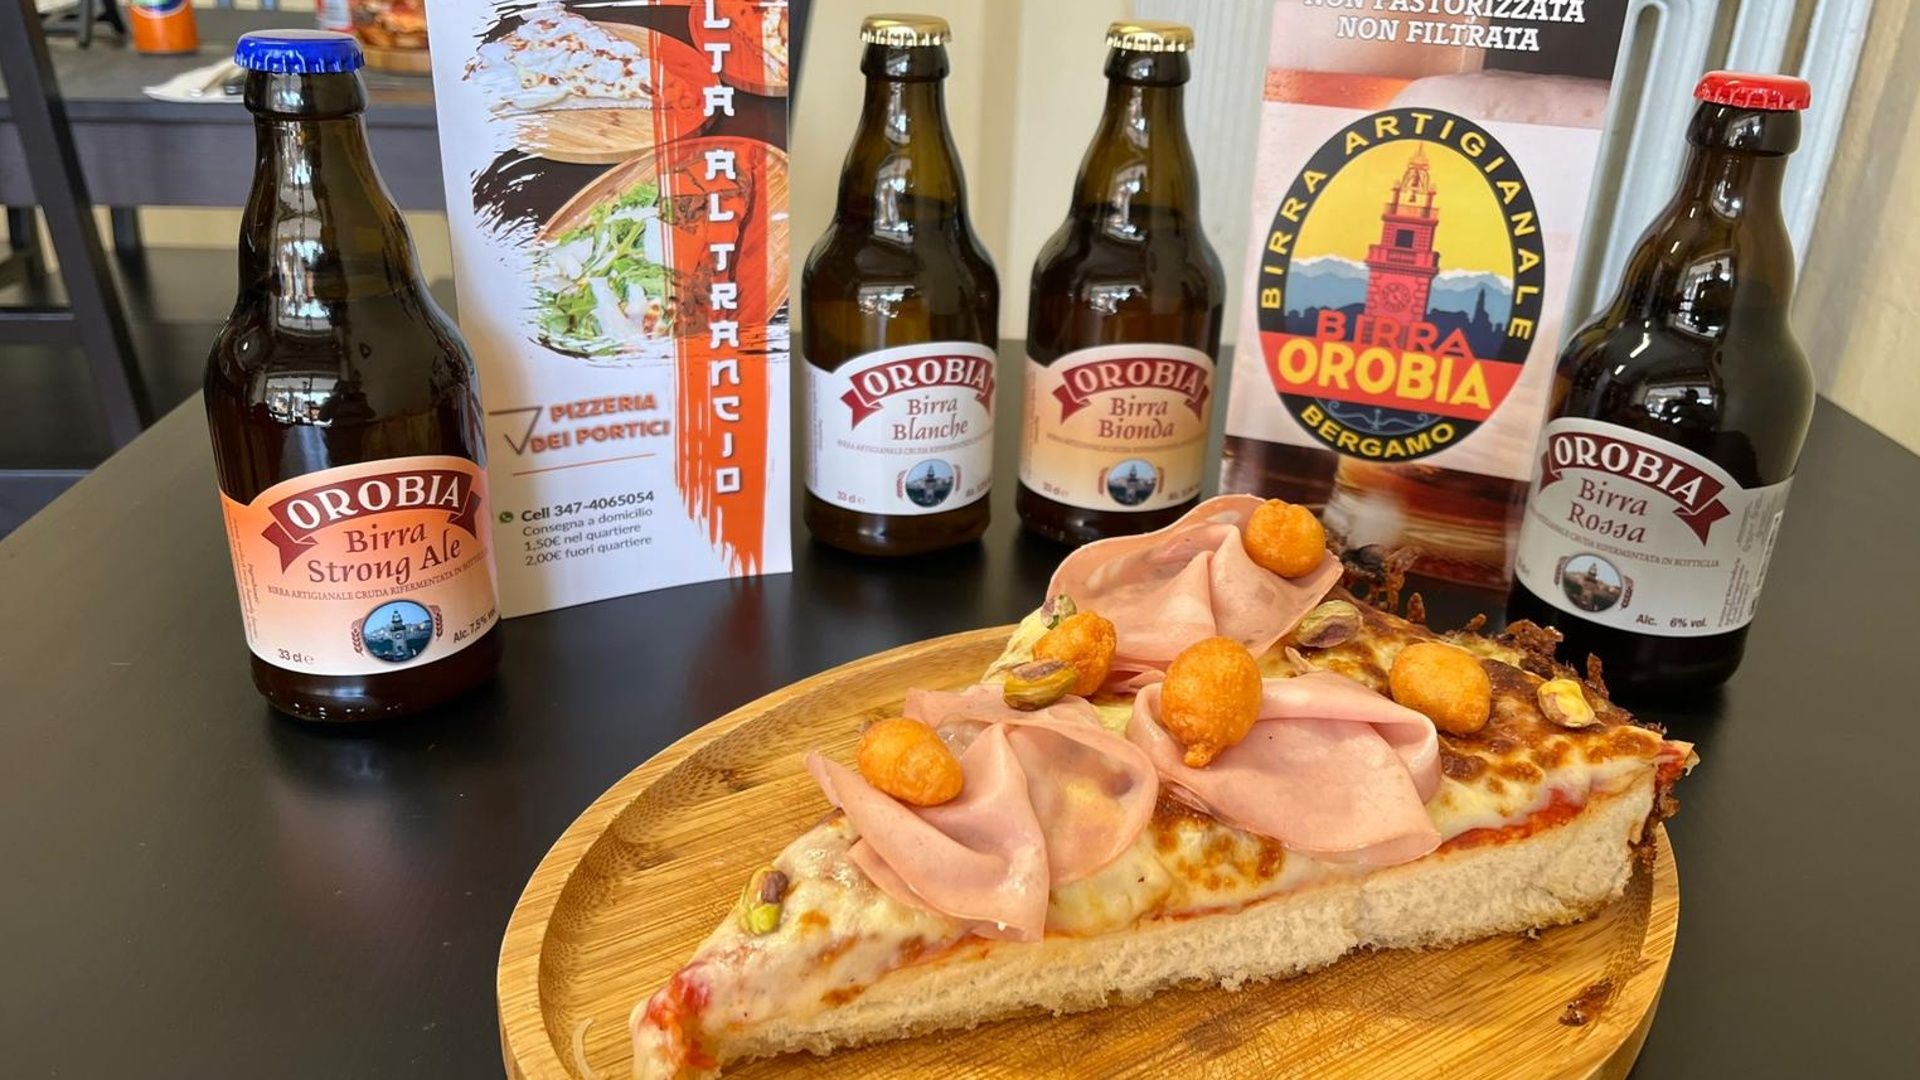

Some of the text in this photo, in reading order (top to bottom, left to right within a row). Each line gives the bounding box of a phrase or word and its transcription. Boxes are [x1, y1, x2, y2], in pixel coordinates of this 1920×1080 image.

[1337, 16, 1540, 51] NON FILTRATA
[704, 149, 736, 222] AL
[1261, 112, 1540, 340] BIRRA ARTIGIANALE
[1316, 309, 1476, 359] BIRRA
[863, 358, 987, 396] OROBIA
[1074, 361, 1200, 394] OROBIA
[1278, 338, 1491, 410] OROBIA
[551, 393, 657, 422] PIZZERIA
[907, 395, 958, 415] Birra
[1110, 395, 1168, 417] Birra
[531, 420, 671, 454] DEI PORTICI
[892, 413, 968, 441] Blanche
[1098, 417, 1176, 440] Bionda
[1301, 404, 1455, 458] BERGAMO
[1554, 436, 1703, 506] OROBIA
[286, 475, 460, 530] OROBIA
[521, 491, 654, 522] Cell 347-4065054
[1579, 477, 1648, 516] Birra
[344, 523, 428, 553] Birra
[523, 508, 653, 537] Consegna a domicilio
[564, 532, 583, 544] nel
[586, 524, 641, 541] quartiere
[1567, 501, 1646, 544] Rossa
[308, 528, 461, 585] Strong Ale
[565, 543, 594, 559] fuori
[597, 536, 652, 554] quartiere
[355, 588, 389, 600] CRUDA
[1669, 617, 1688, 628] 6%
[278, 649, 302, 664] 33 cl
